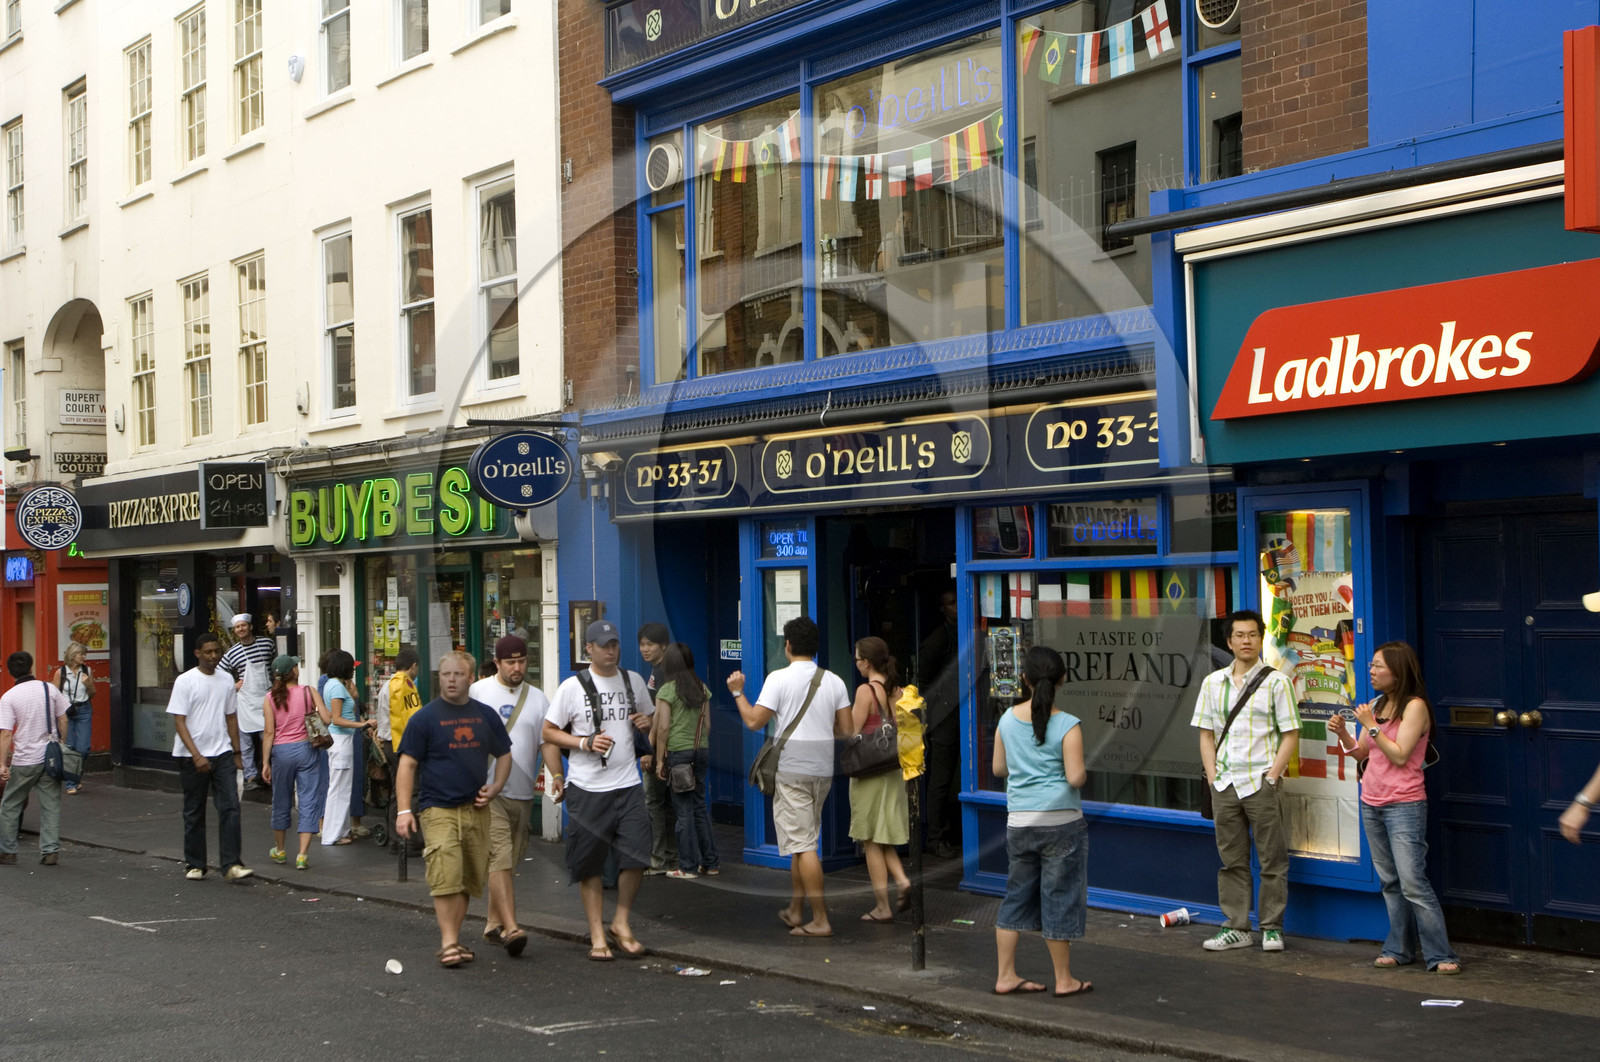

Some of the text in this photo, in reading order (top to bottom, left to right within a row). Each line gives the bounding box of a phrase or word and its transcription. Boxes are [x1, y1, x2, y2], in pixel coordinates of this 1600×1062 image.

[1247, 320, 1534, 405] Ladbrokes
[65, 392, 101, 403] RUPERT
[65, 403, 96, 413] COURT
[55, 454, 106, 463] RUPERT
[60, 463, 103, 473] COURT
[667, 459, 723, 488] 33-37
[209, 473, 263, 491] OPEN
[35, 508, 66, 516] PIZZA
[210, 498, 232, 517] 24
[26, 515, 75, 524] EXPRESS
[769, 532, 794, 545] OPEN
[1287, 594, 1314, 606] HOEVER
[1314, 592, 1328, 603] YOU
[1292, 601, 1350, 618] TCH THEM HER
[1076, 632, 1163, 646] A TASTE OF
[1060, 651, 1192, 688] RELAND
[1099, 704, 1142, 730] £4.50
